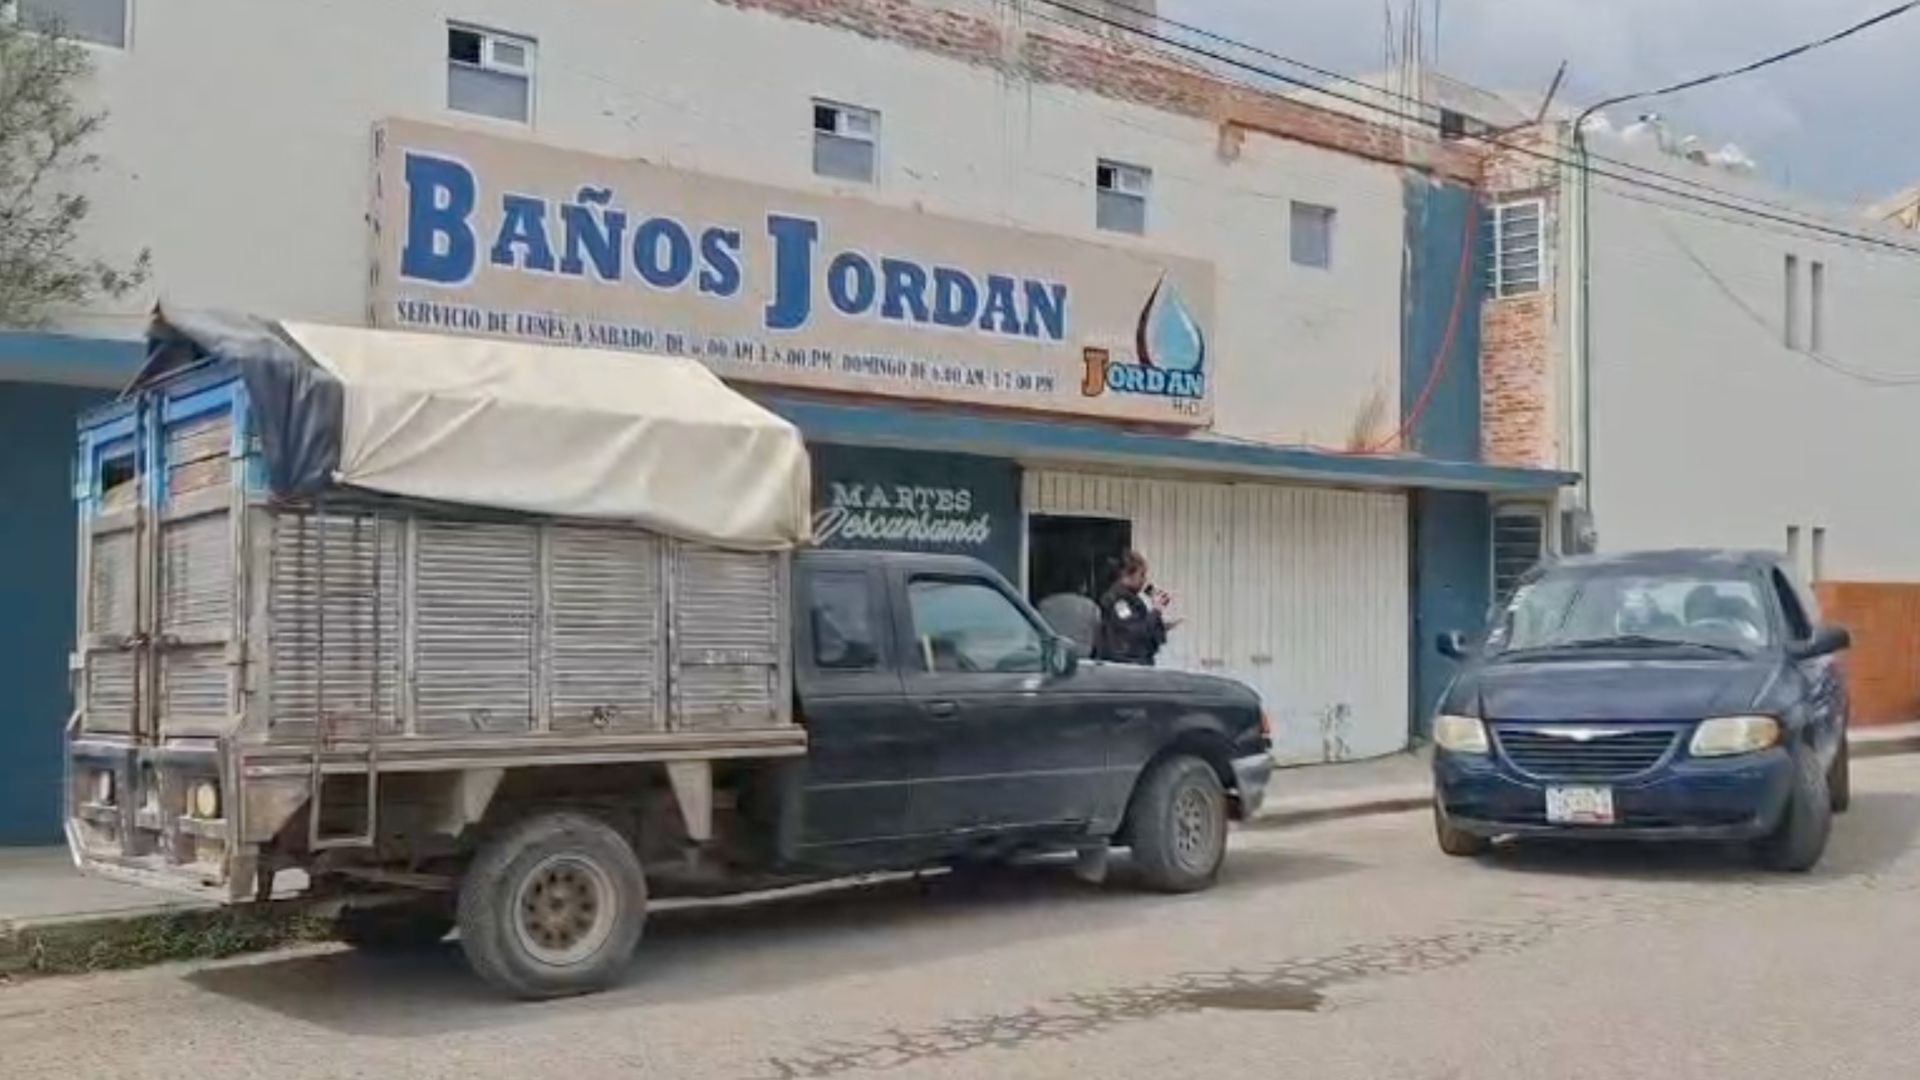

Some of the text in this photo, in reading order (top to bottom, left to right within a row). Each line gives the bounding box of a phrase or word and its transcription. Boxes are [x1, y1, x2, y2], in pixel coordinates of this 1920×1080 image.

[400, 151, 742, 298] BAÑOS
[764, 213, 1067, 340] JORDAN
[396, 299, 481, 330] SERVICIO
[487, 311, 508, 333] DE
[841, 353, 906, 377] DOMINGO
[910, 360, 926, 381] DE
[1081, 346, 1205, 400] JORDAN
[831, 482, 972, 513] MARTES
